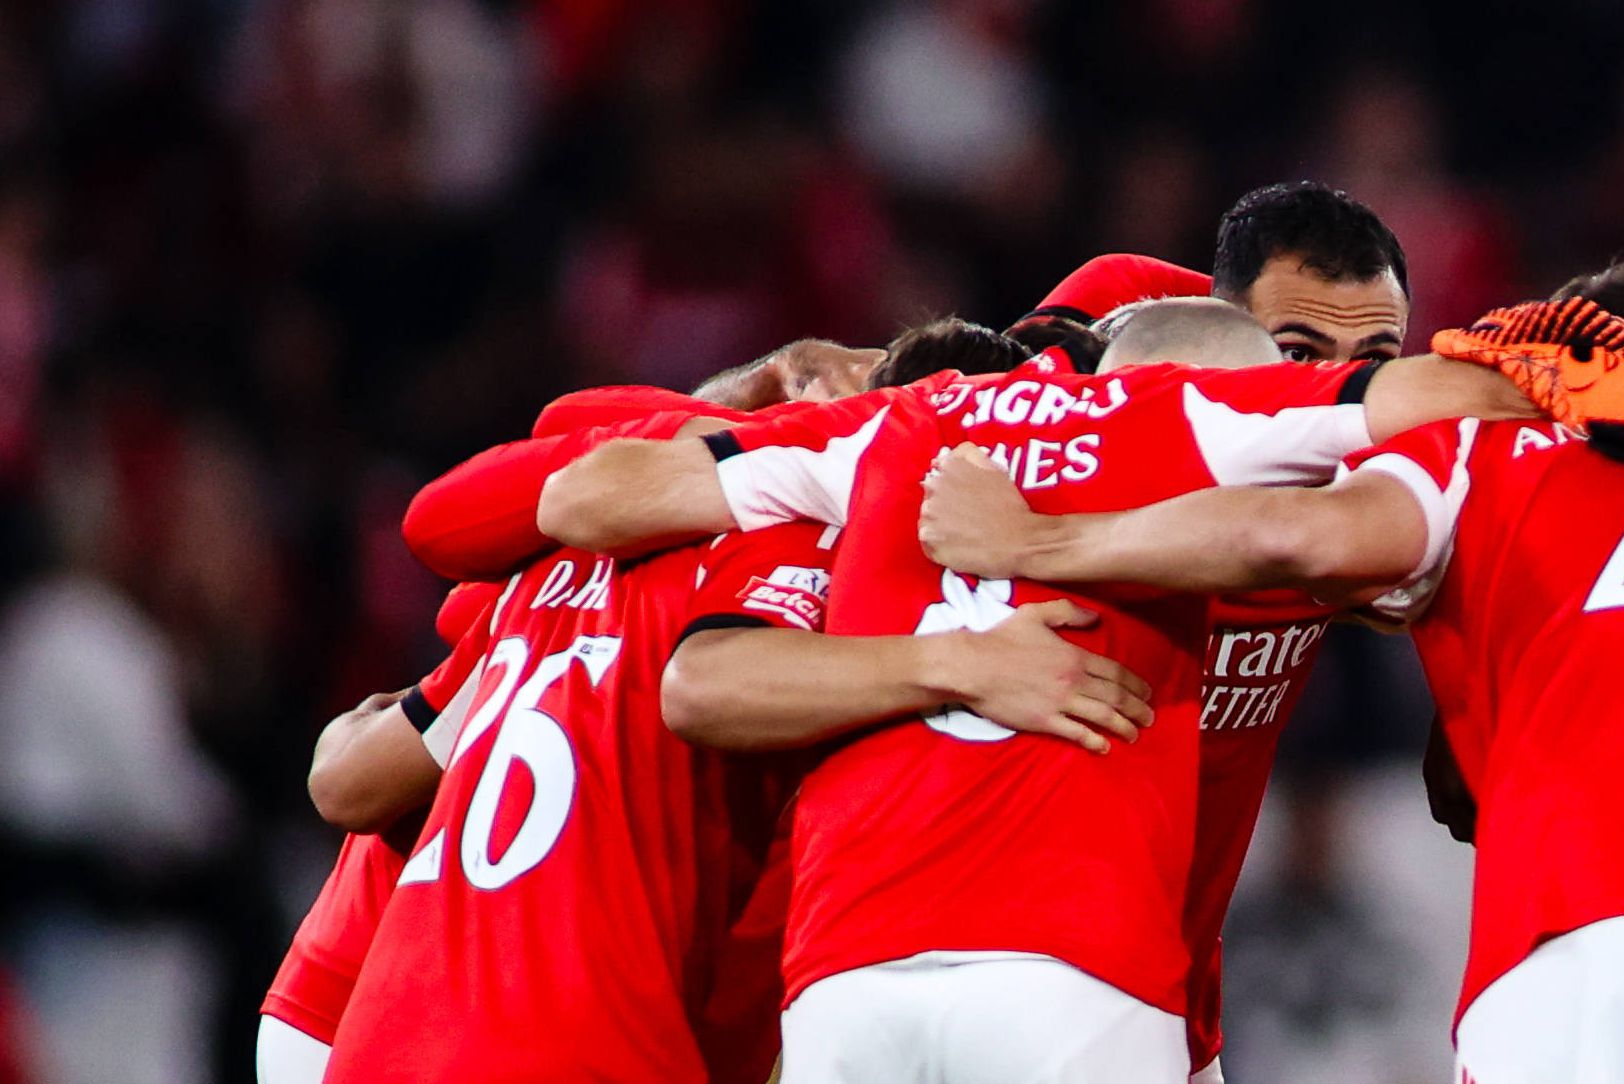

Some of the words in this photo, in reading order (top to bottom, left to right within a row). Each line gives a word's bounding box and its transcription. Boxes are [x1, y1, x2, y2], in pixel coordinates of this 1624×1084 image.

[1204, 617, 1332, 677] rate
[1199, 680, 1290, 730] ETTER
[396, 634, 622, 890] 26
